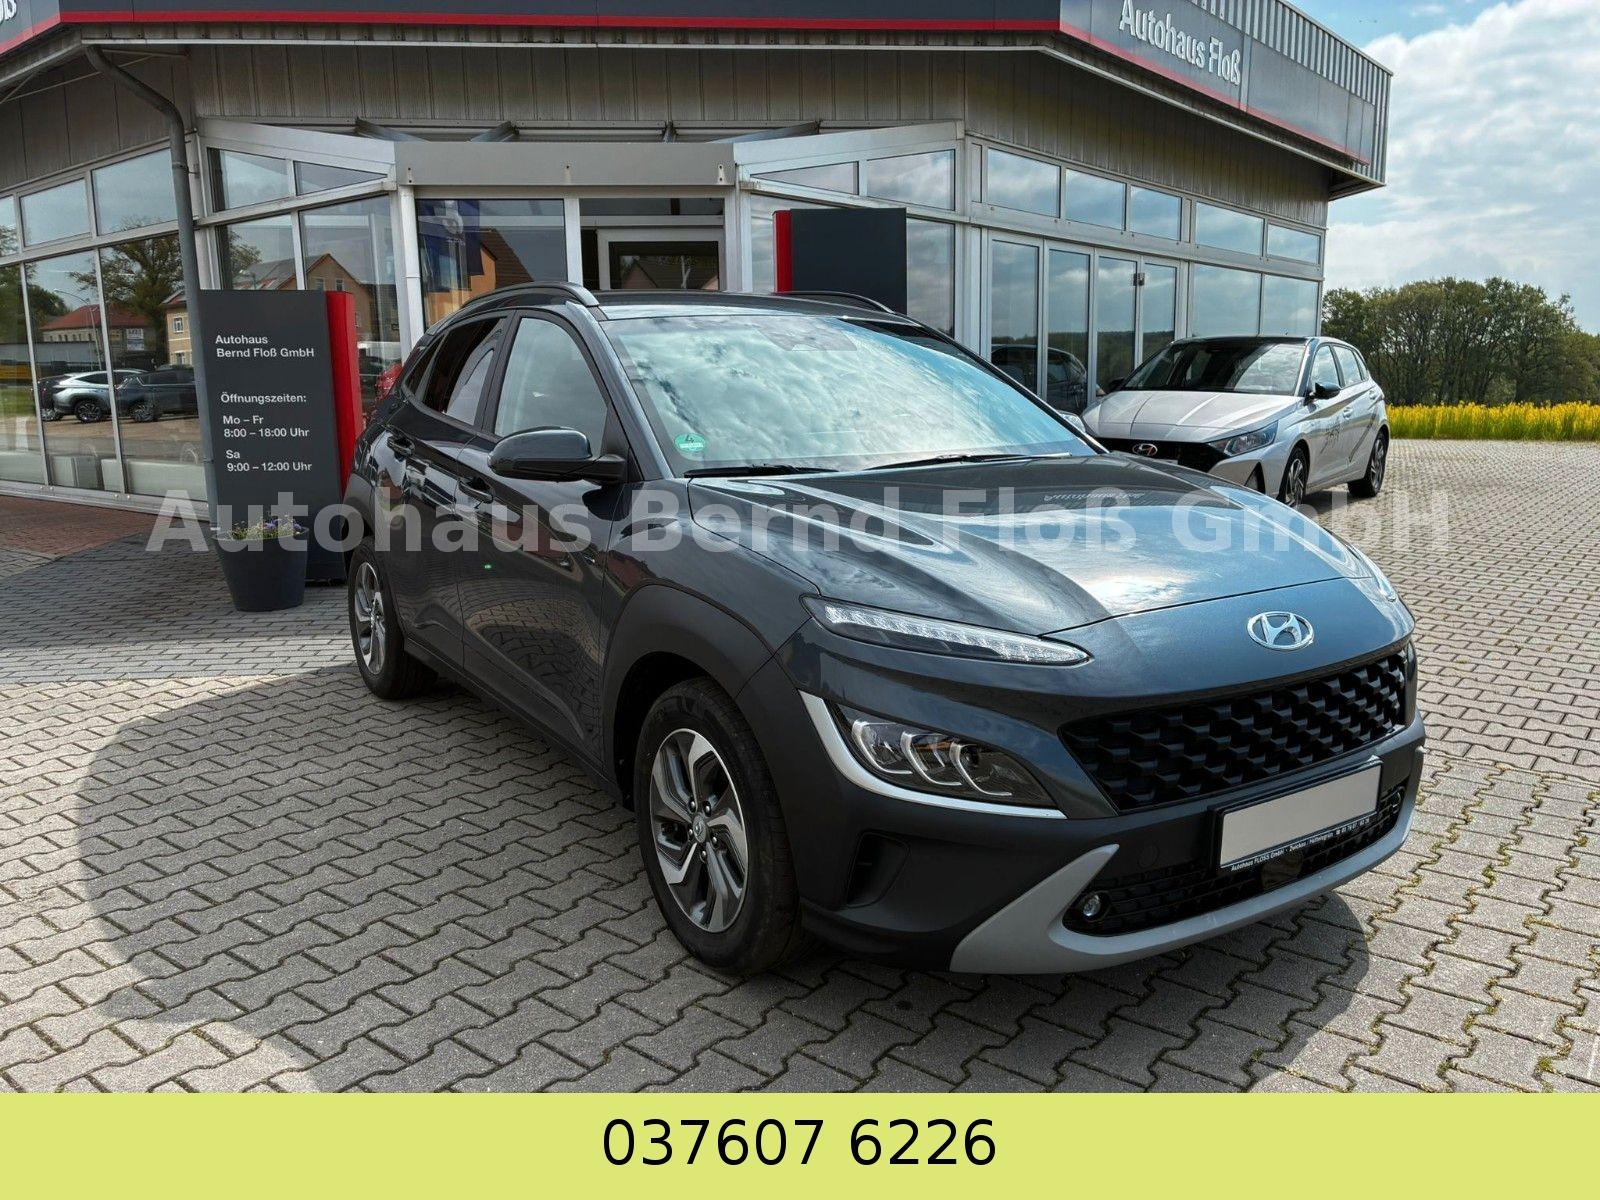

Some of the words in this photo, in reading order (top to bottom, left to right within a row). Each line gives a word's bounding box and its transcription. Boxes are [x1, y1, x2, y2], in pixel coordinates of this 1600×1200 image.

[1119, 0, 1206, 69] Autohaus
[1208, 36, 1241, 86] Floß
[215, 334, 269, 345] Autohaus
[216, 347, 251, 358] Bernd
[253, 347, 278, 358] Floß
[280, 347, 315, 358] GmbH
[220, 391, 307, 405] Öffnungszeiten:
[223, 415, 241, 425] Mo
[252, 415, 264, 425] Fr
[223, 428, 247, 438] 8:00
[258, 428, 287, 437] 18:00
[290, 427, 310, 437] Uhr
[225, 450, 241, 460] Sa
[227, 462, 250, 472] 9:00
[261, 462, 290, 472] 12:00
[292, 462, 313, 472] Uhr
